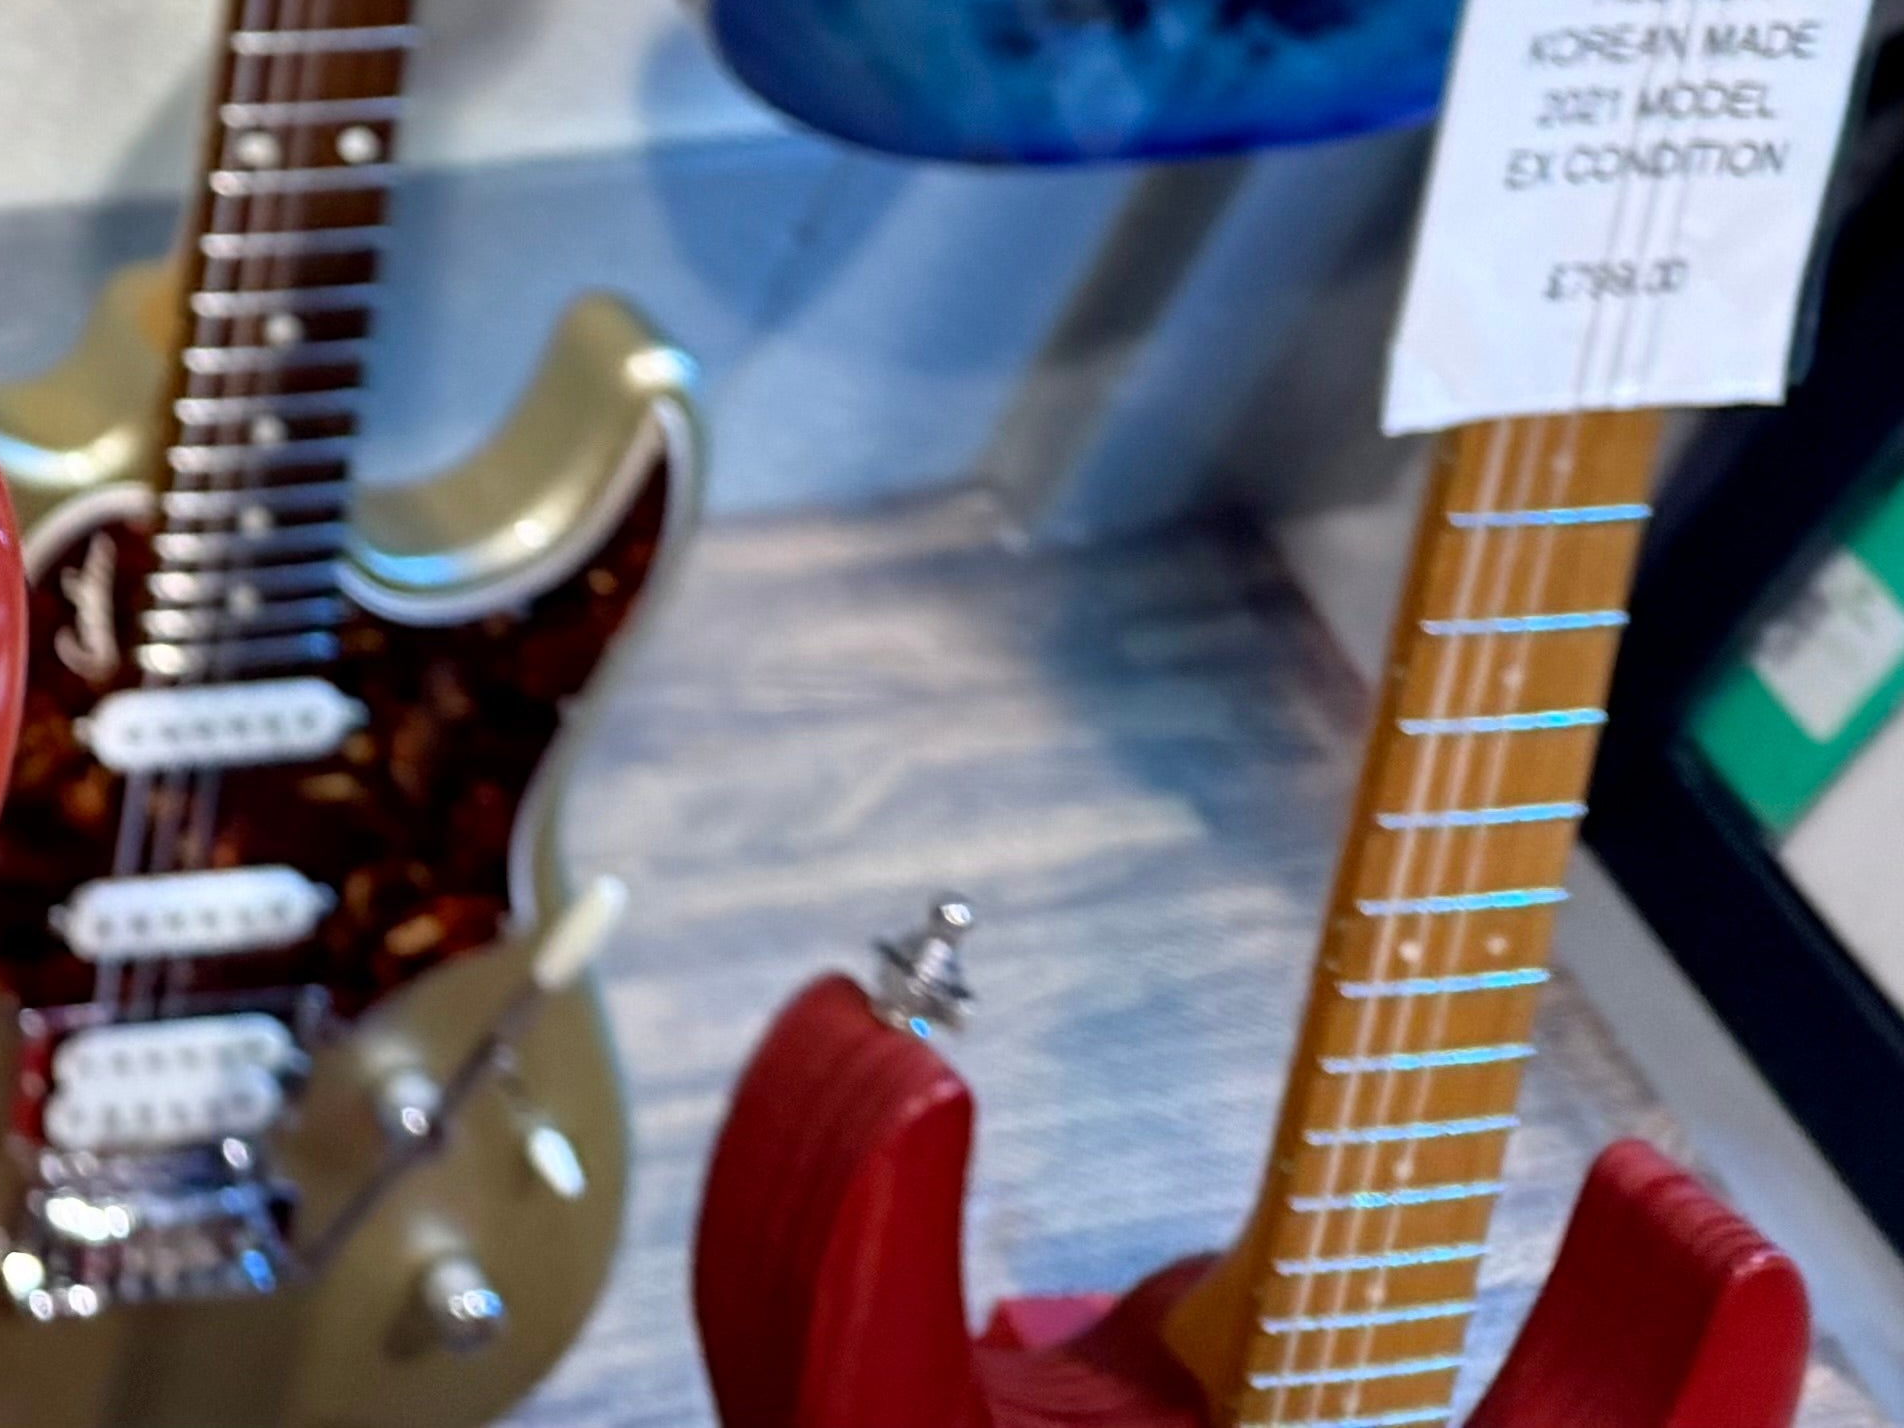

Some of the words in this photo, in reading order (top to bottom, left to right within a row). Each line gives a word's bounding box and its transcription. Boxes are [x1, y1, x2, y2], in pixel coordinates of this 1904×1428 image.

[1527, 23, 1688, 65] KOREAN
[1702, 17, 1822, 59] MADE
[1636, 78, 1776, 120] MODEL
[1503, 147, 1552, 189] EX
[1564, 138, 1790, 184] CONDITION
